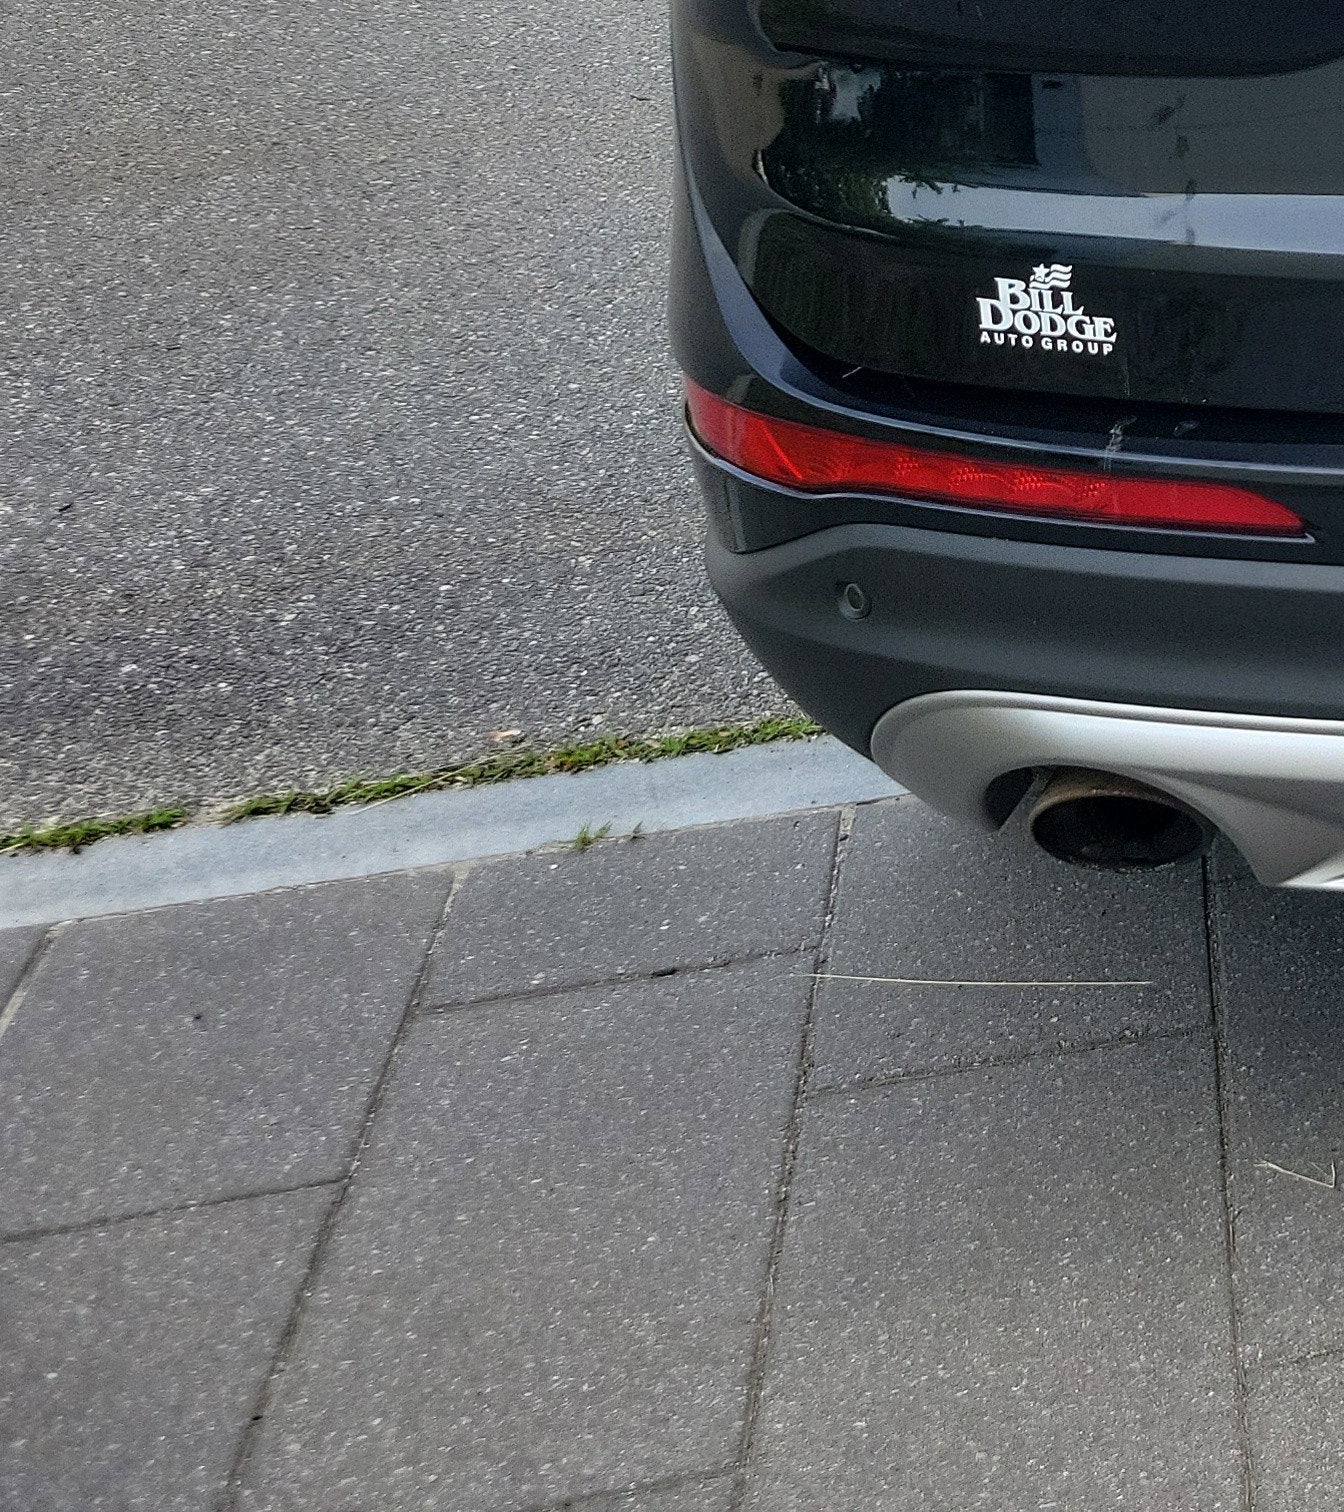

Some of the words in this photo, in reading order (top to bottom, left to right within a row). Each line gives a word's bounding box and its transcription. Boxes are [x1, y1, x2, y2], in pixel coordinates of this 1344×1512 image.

[994, 277, 1084, 315] BILL
[976, 297, 1118, 343] DODGE
[980, 331, 1034, 348] AUTO
[1041, 339, 1114, 356] GROUP
